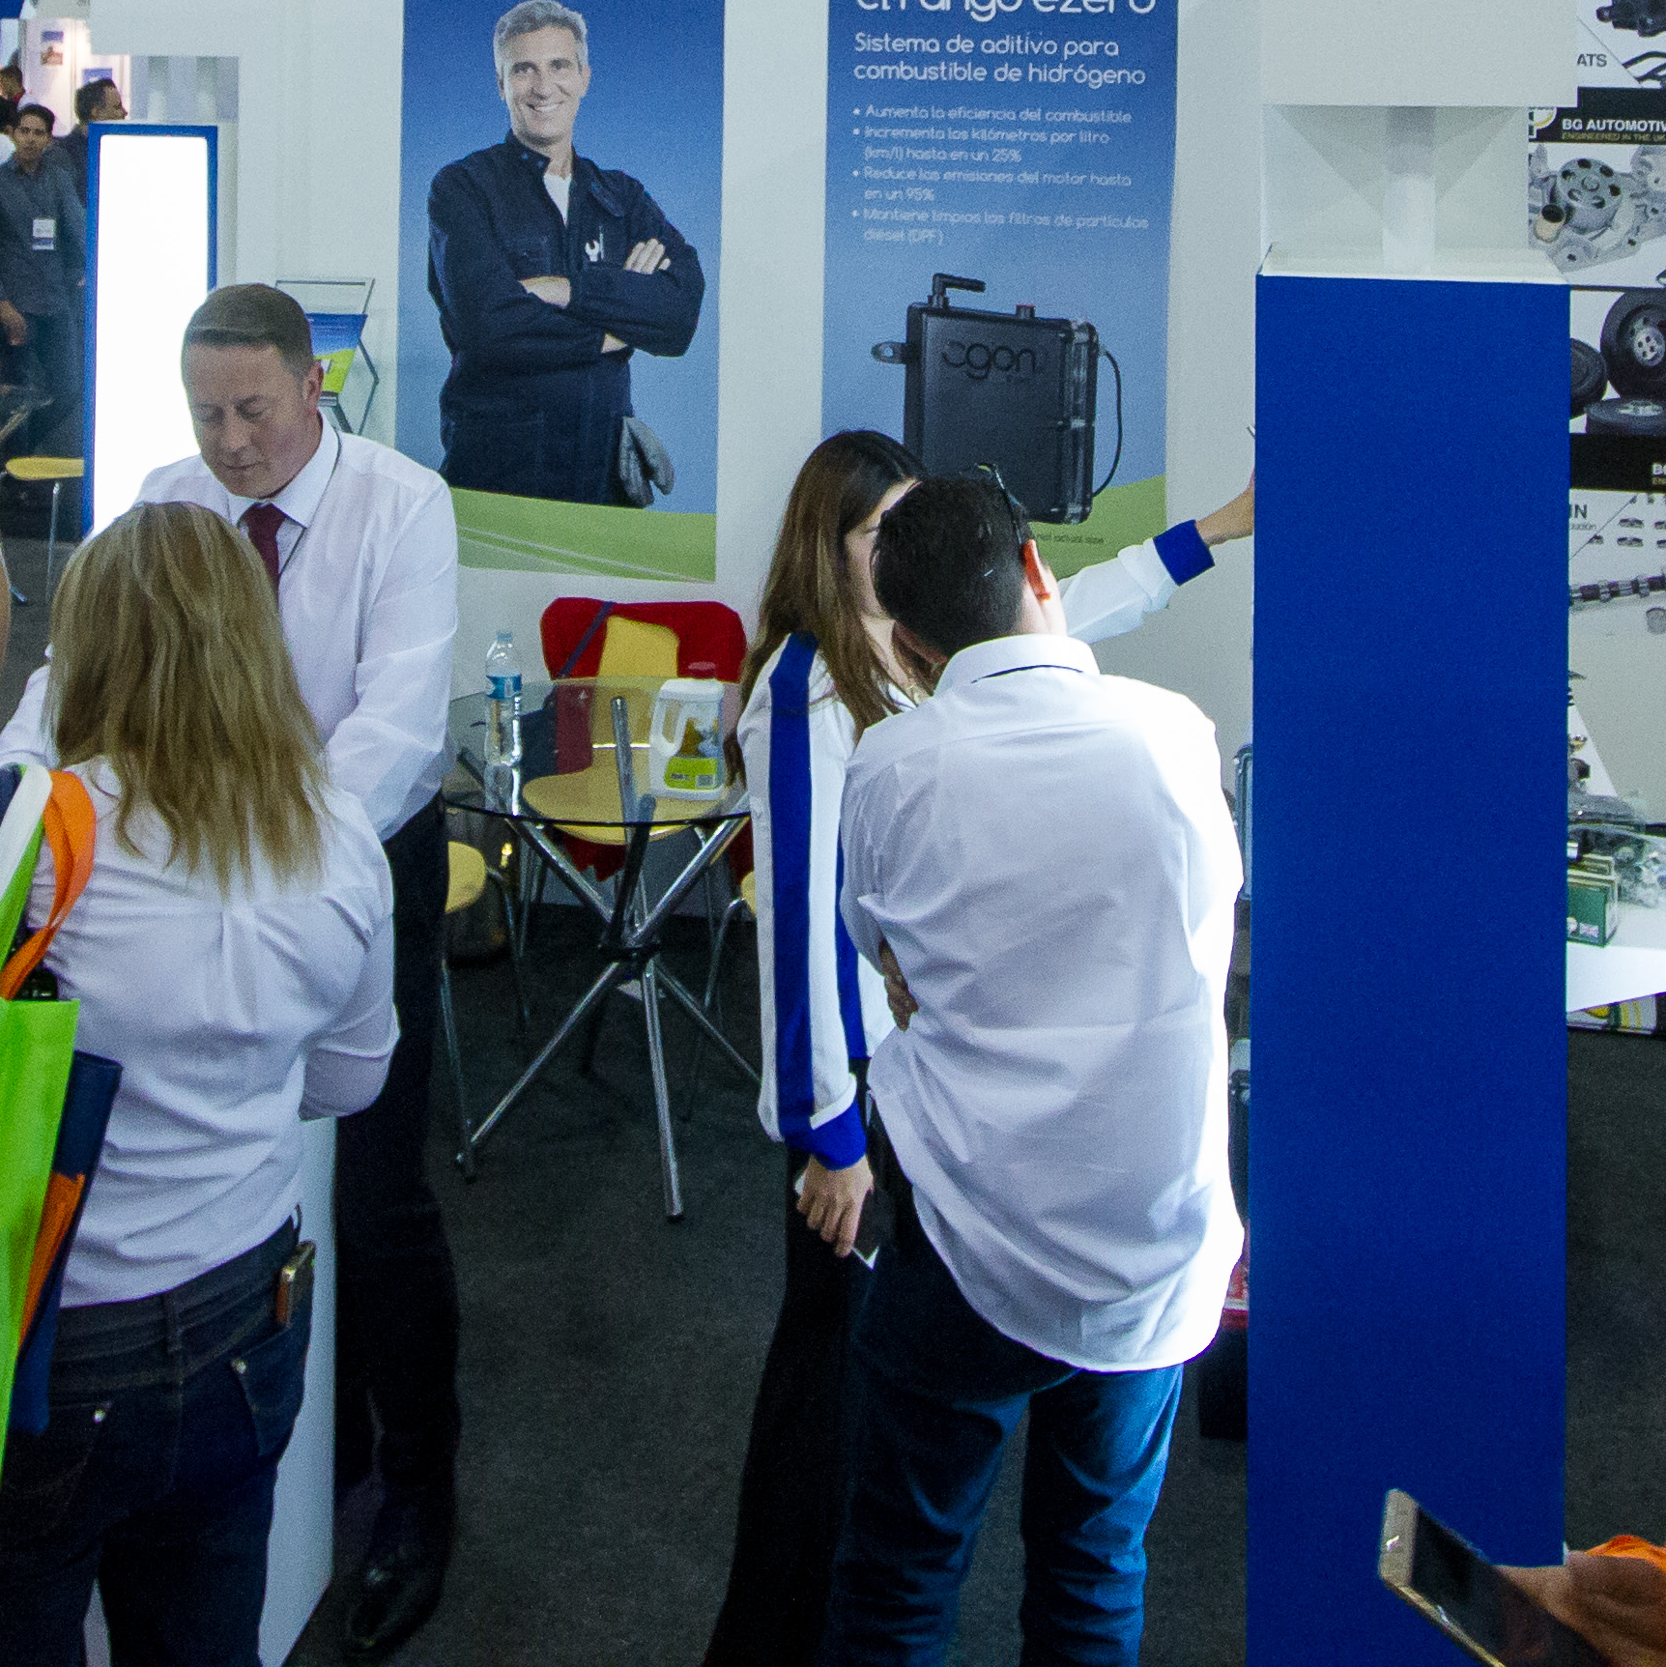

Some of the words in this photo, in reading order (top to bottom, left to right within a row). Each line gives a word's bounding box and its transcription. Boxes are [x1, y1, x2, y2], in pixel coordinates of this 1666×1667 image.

[855, 32, 940, 53] Sistema
[945, 34, 975, 53] de
[981, 32, 1058, 55] aditivo
[1064, 38, 1119, 61] para
[854, 61, 988, 82] combustible
[994, 62, 1023, 83] de
[1028, 63, 1146, 89] hidrógeno
[865, 104, 929, 119] Aumenta
[1045, 110, 1132, 124] combustible
[1562, 118, 1583, 131] BG
[1050, 132, 1076, 145] por
[950, 151, 968, 161] en
[942, 340, 1036, 381] cgon
